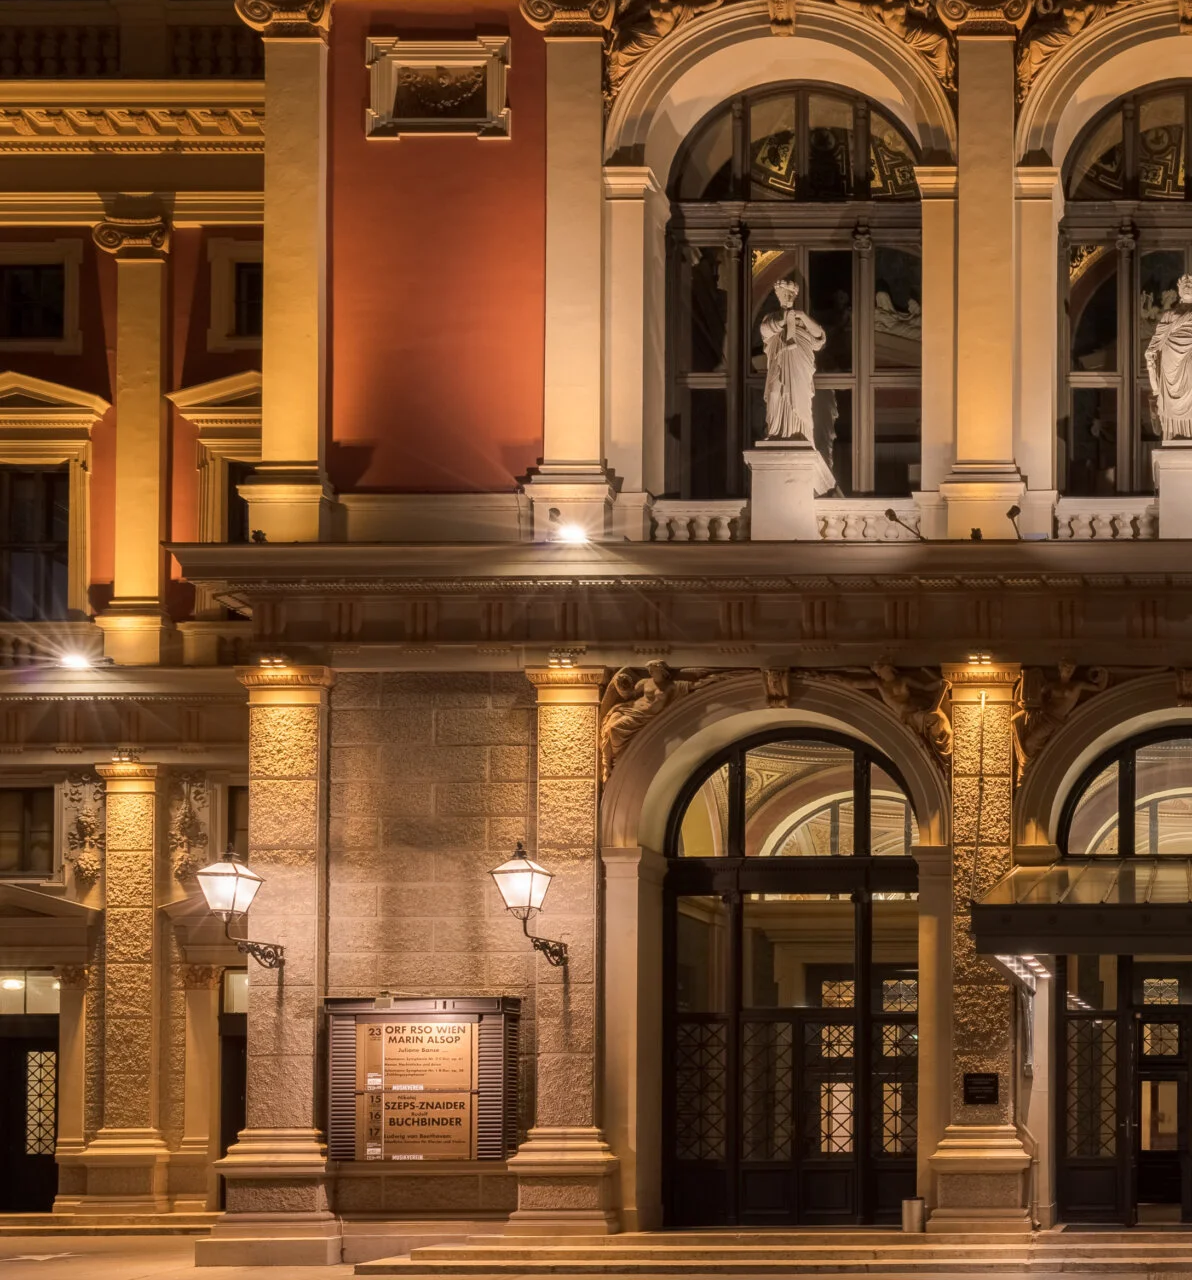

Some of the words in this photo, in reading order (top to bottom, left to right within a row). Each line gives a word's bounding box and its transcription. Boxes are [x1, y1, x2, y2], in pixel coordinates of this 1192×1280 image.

[368, 1028, 382, 1036] 23
[385, 1026, 407, 1034] ORF
[410, 1026, 433, 1034] RSO
[436, 1026, 466, 1034] WIEN
[388, 1036, 424, 1044] MARIN
[427, 1036, 461, 1044] ALSOP
[369, 1095, 381, 1103] 15
[384, 1102, 466, 1110] SZEPS-ZNAIDER
[369, 1111, 381, 1120] 16
[389, 1117, 462, 1126] BUCHBINDER
[369, 1128, 380, 1137] 17
